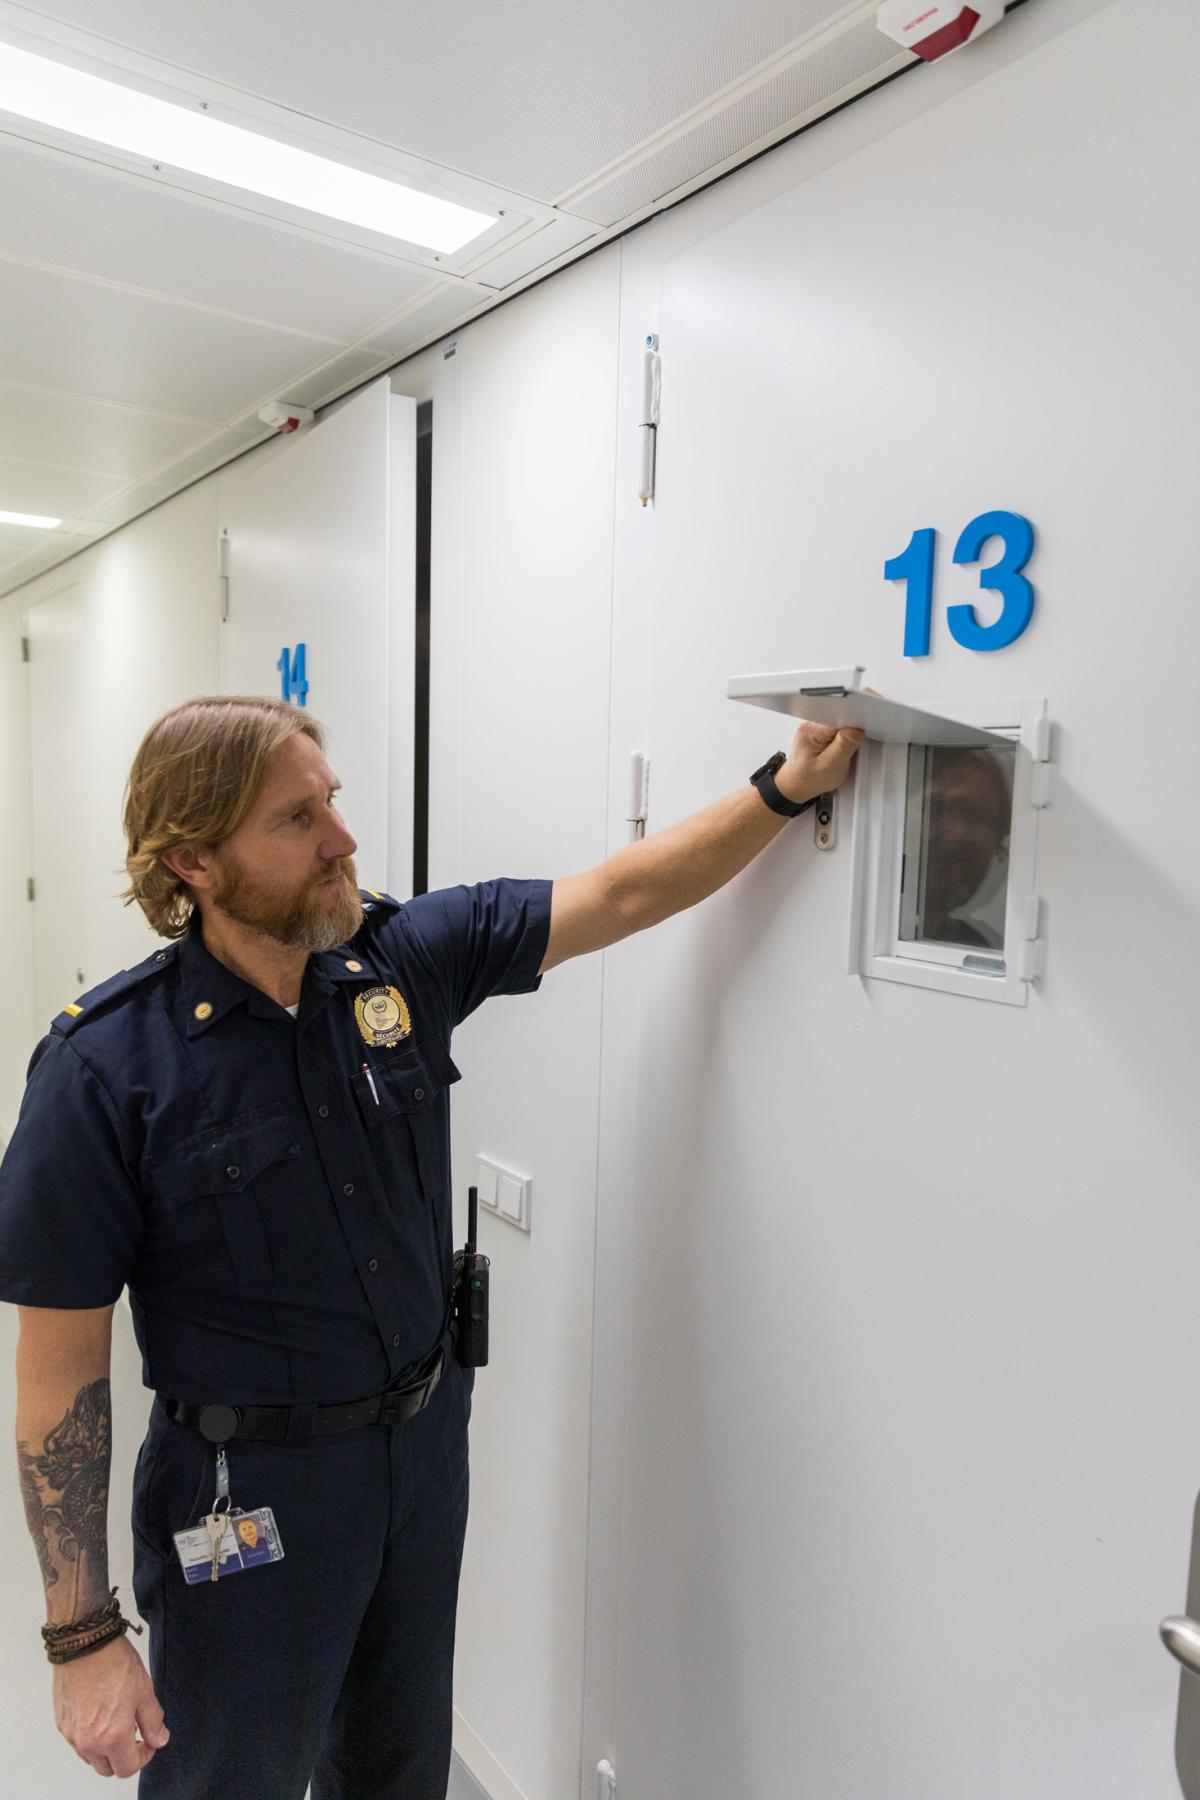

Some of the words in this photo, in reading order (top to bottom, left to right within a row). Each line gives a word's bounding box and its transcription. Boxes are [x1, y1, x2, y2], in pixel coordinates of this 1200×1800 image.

[884, 510, 1035, 657] 13
[277, 643, 308, 707] 14
[362, 988, 389, 1000] SECURITY
